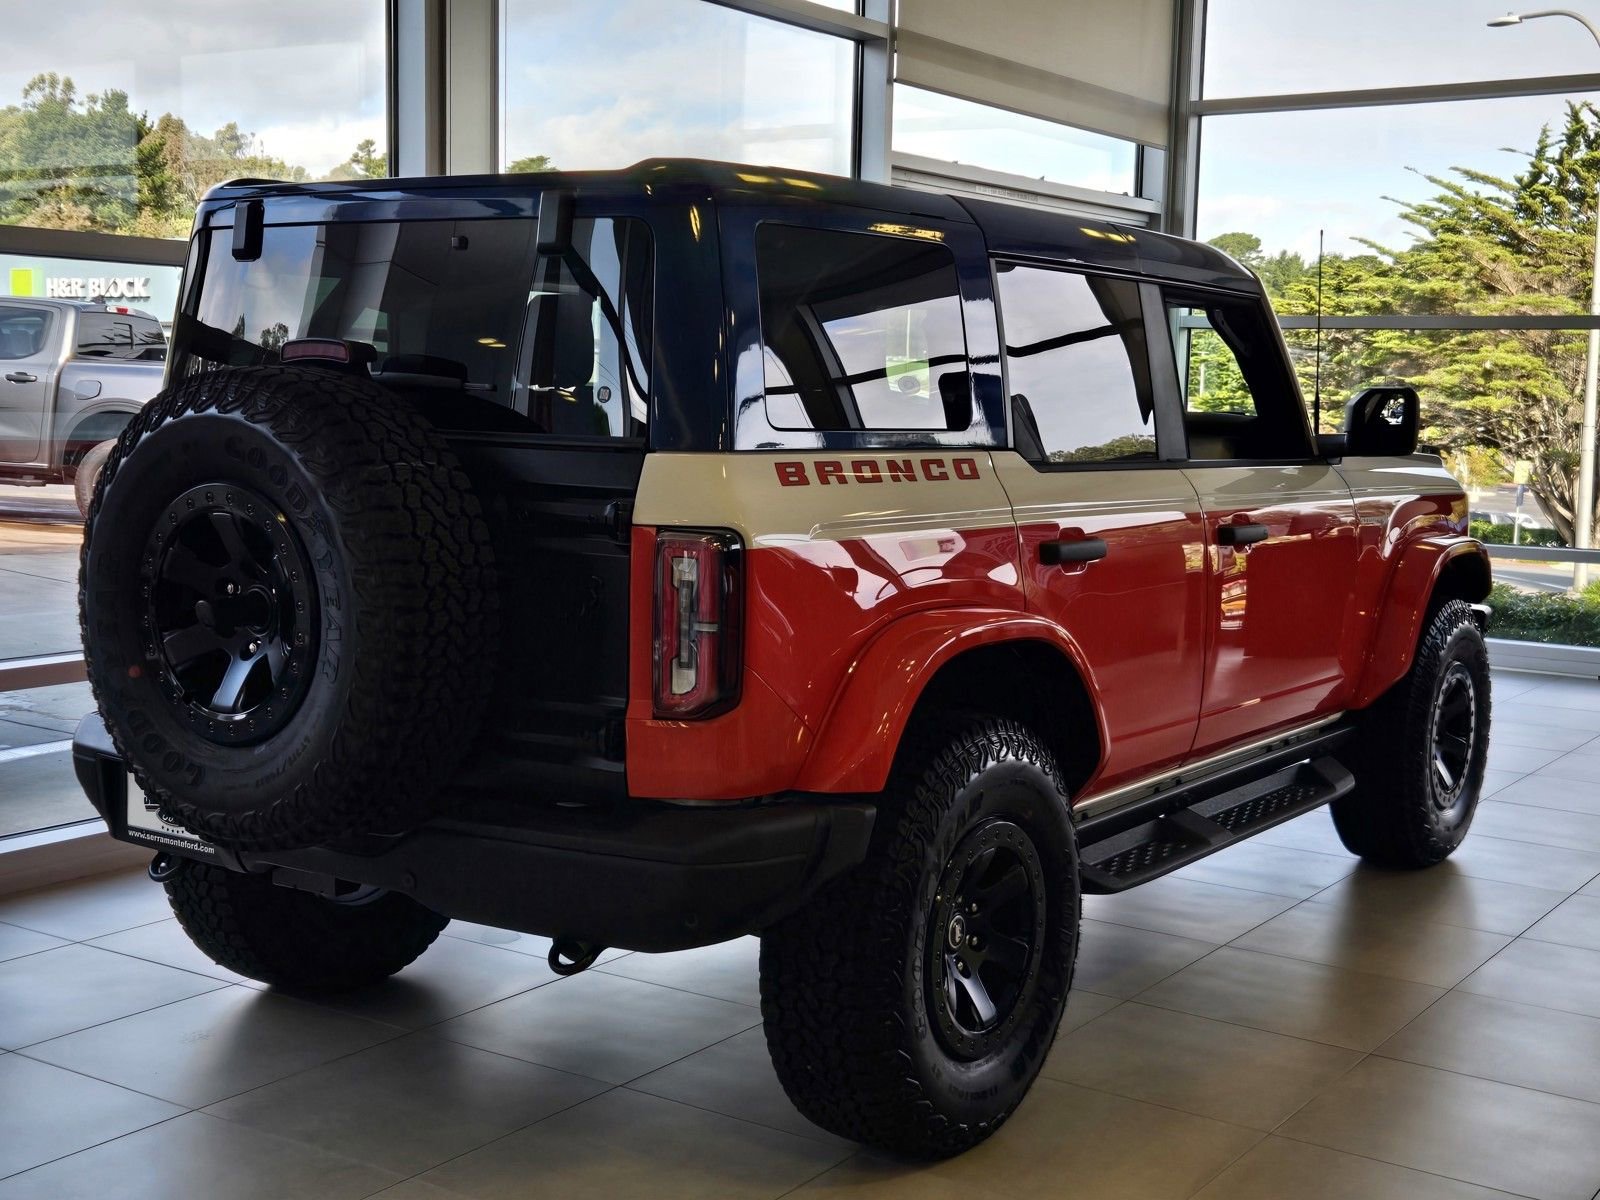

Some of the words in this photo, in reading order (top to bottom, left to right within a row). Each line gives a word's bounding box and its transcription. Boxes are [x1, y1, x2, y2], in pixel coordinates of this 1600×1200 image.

[45, 277, 84, 298] H&R
[88, 277, 149, 299] BLOCK
[774, 458, 981, 487] BRONCO
[224, 433, 342, 685] GOODYEAR
[127, 829, 215, 855] www.serramonteford.com
